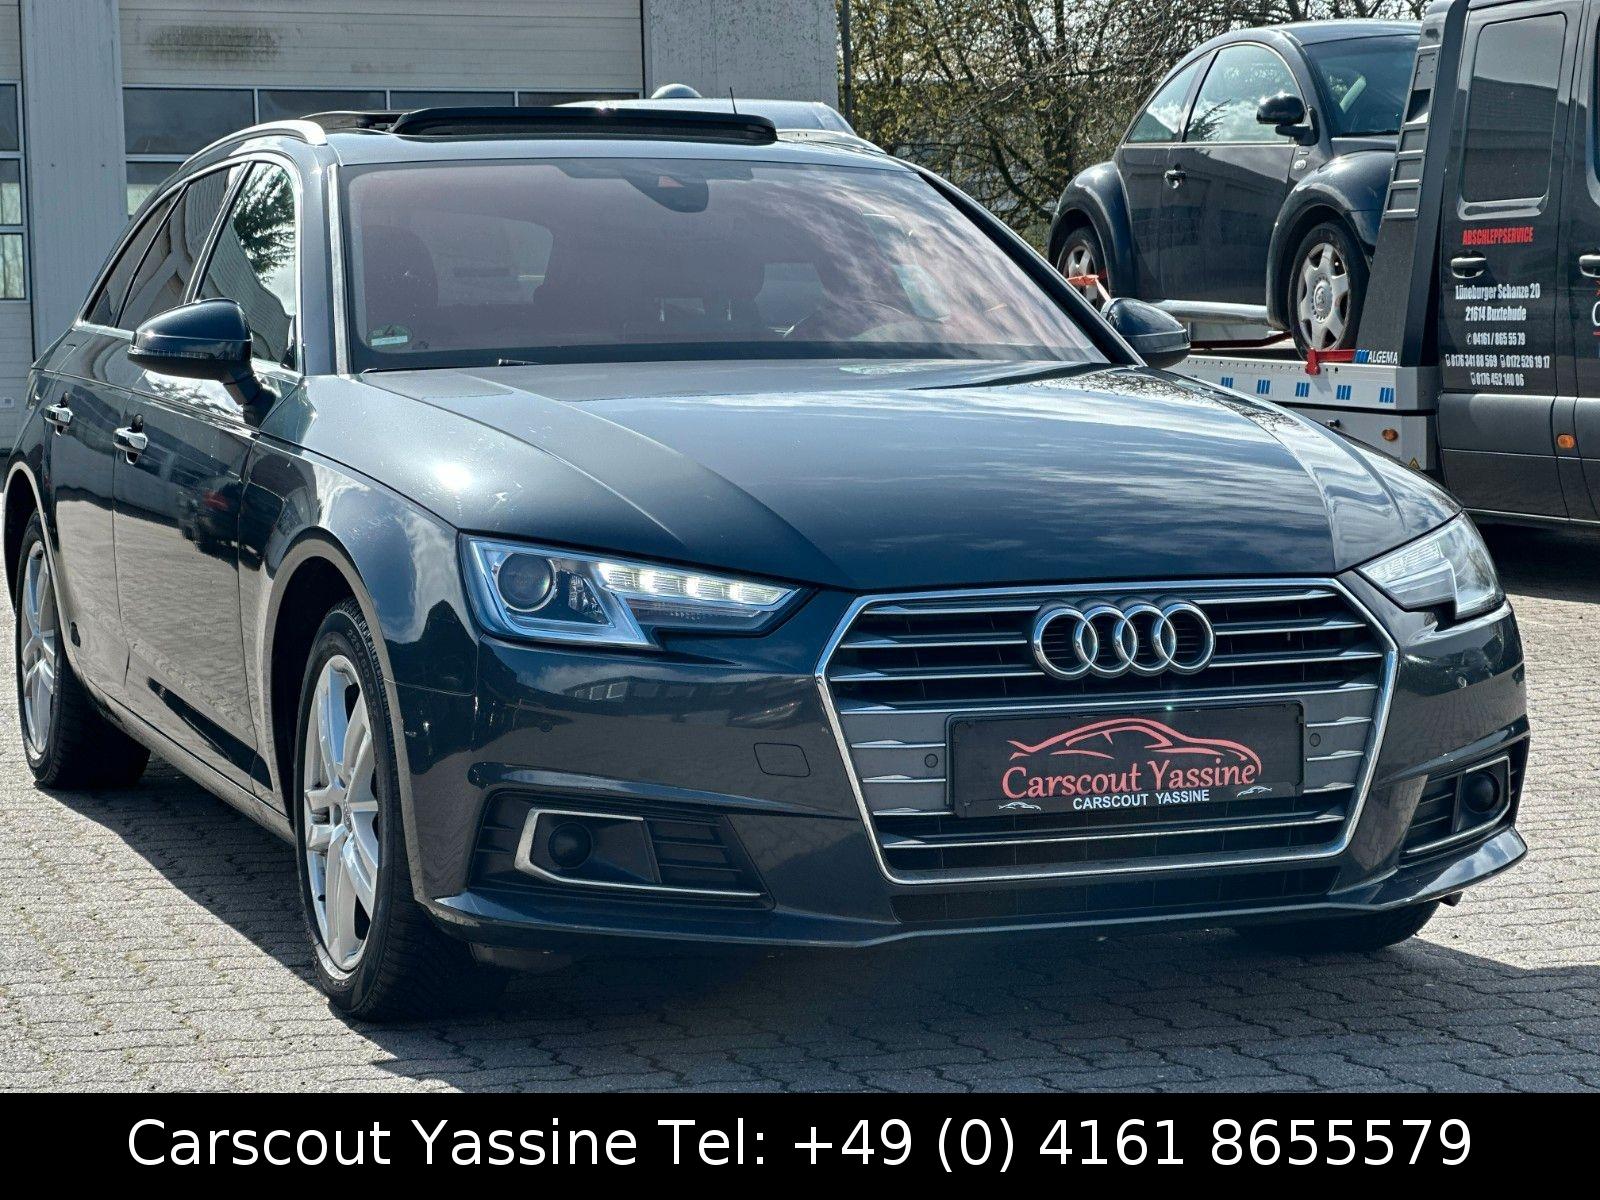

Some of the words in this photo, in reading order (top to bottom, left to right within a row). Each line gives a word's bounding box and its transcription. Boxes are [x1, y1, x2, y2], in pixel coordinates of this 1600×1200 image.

[1462, 227, 1534, 245] ABSCHLEPPSERVICE
[1455, 285, 1497, 301] Lüneburger
[1497, 284, 1529, 299] Schanze
[1530, 283, 1540, 299] 20
[1465, 305, 1486, 322] 21614
[1486, 305, 1527, 321] Buxtehude
[1472, 332, 1490, 346] 04161
[1508, 332, 1517, 346] 55
[1517, 332, 1526, 346] 79
[1367, 350, 1398, 364] ALGEMA
[1001, 763, 1143, 798] Carscout
[1148, 758, 1257, 790] Yassine
[1073, 793, 1149, 810] CARSCOUT
[1155, 789, 1210, 805] YASSINE
